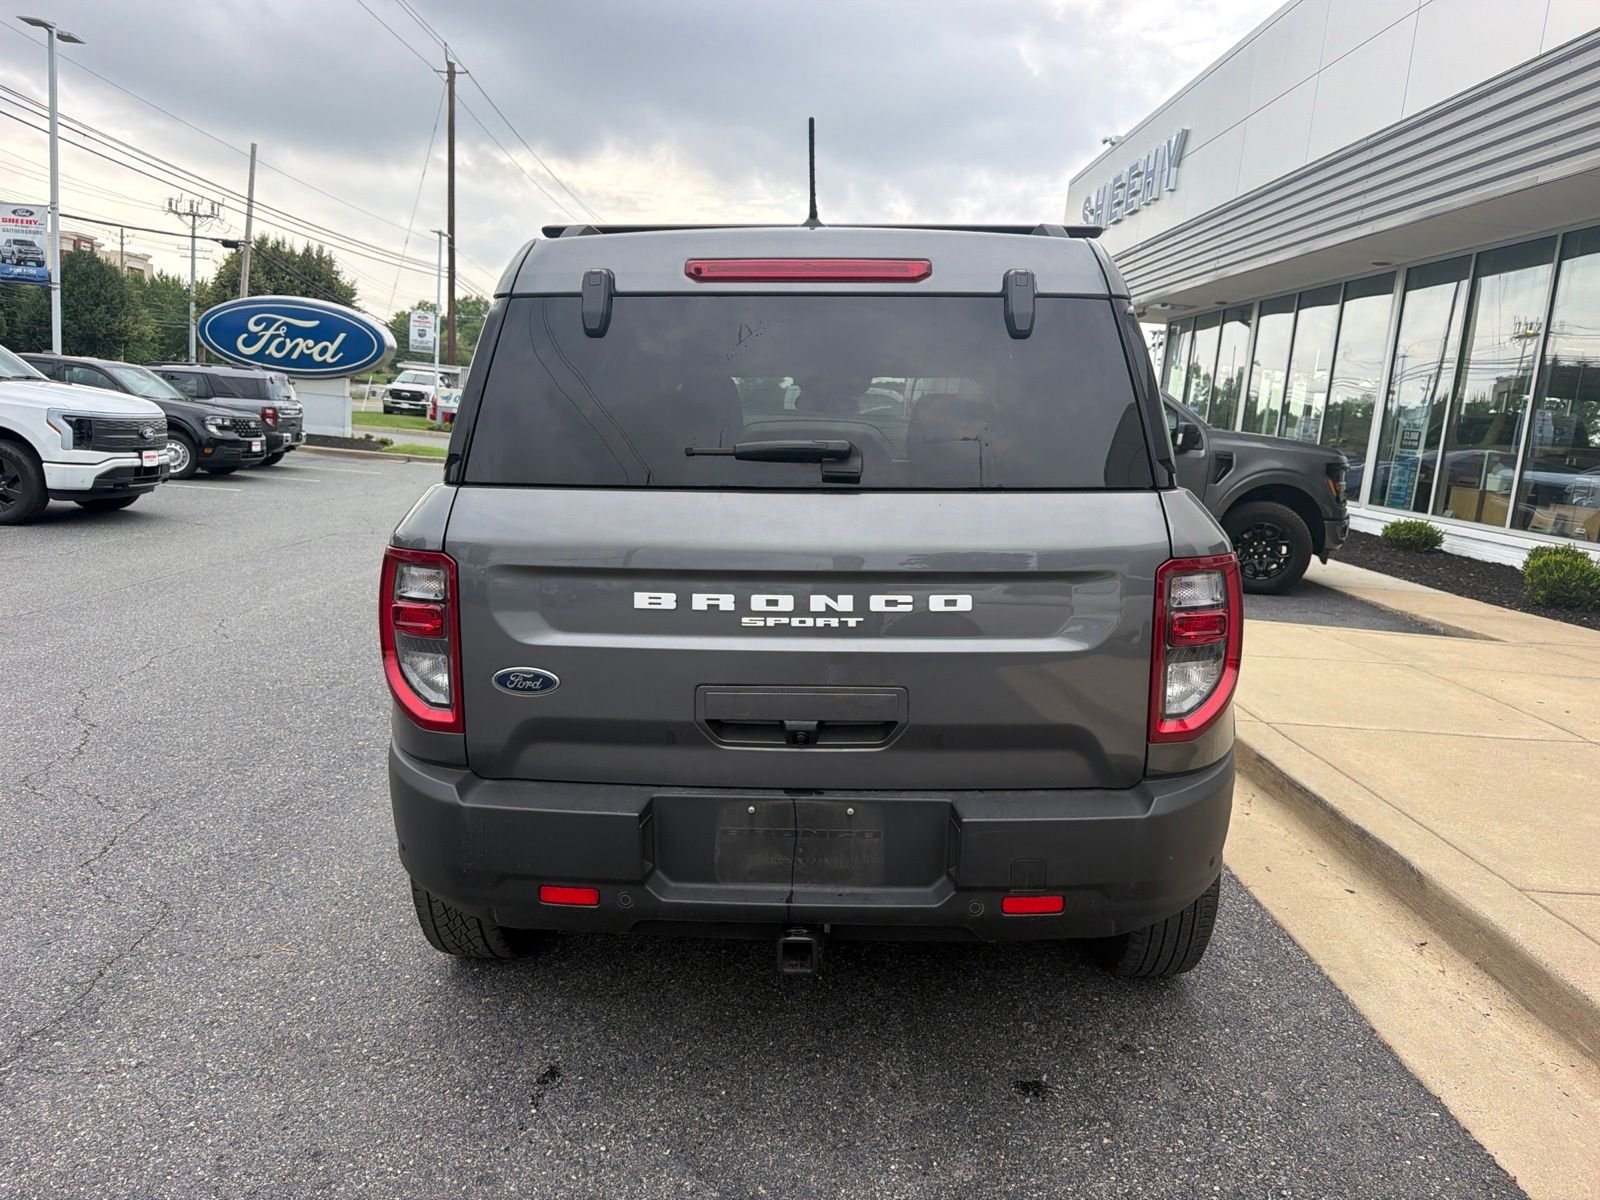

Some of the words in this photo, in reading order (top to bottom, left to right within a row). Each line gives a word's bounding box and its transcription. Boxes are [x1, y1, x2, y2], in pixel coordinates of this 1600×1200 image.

[1081, 128, 1189, 231] SHEEHY
[1, 217, 39, 225] SHEEHY
[236, 313, 347, 364] Ford
[633, 591, 973, 613] BRONCO
[741, 616, 864, 628] SPORT
[504, 672, 544, 692] Ford
